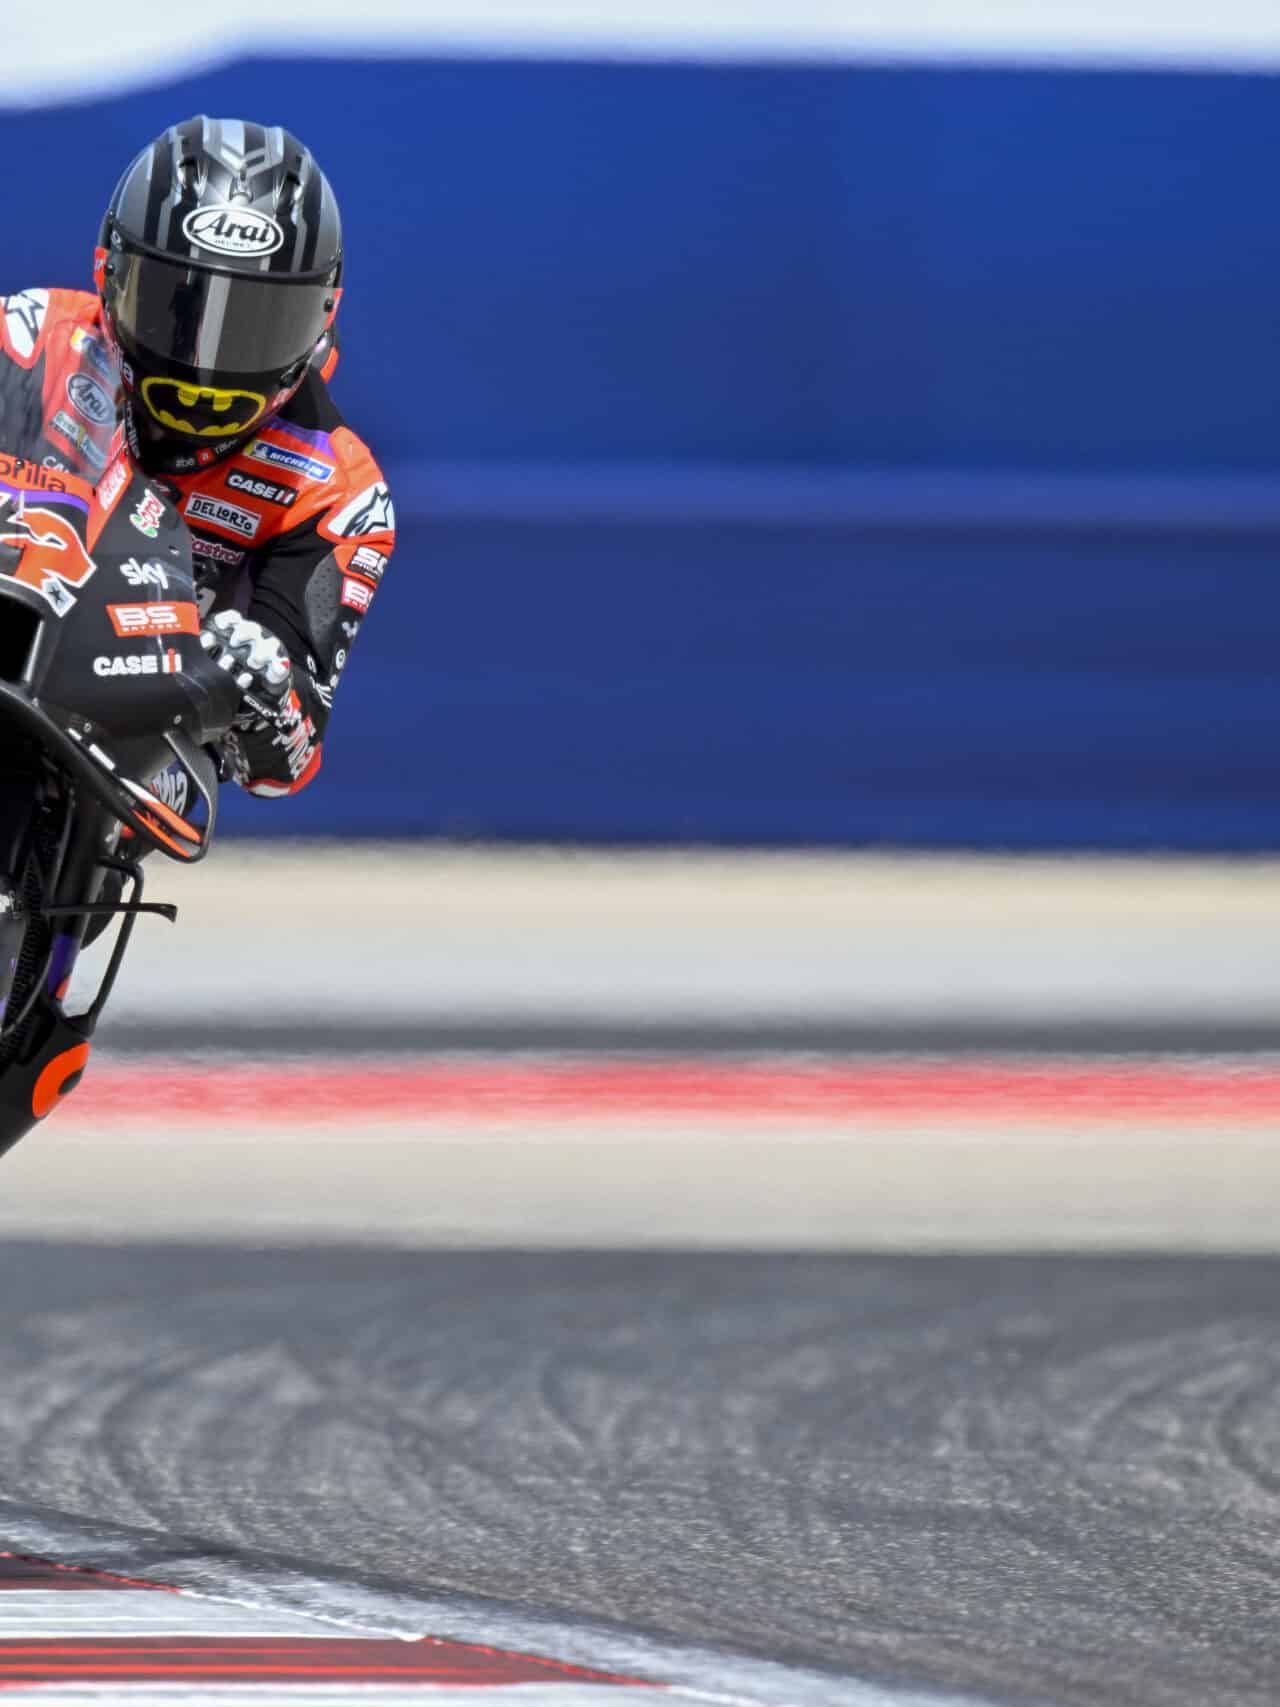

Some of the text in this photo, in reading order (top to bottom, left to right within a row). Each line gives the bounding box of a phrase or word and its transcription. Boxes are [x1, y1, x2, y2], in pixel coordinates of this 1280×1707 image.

[191, 212, 271, 243] Arai
[73, 377, 108, 418] Arai
[227, 474, 277, 500] CASE
[192, 540, 244, 564] astrol
[120, 558, 169, 590] sky
[115, 605, 178, 625] BS
[93, 655, 158, 676] CASE
